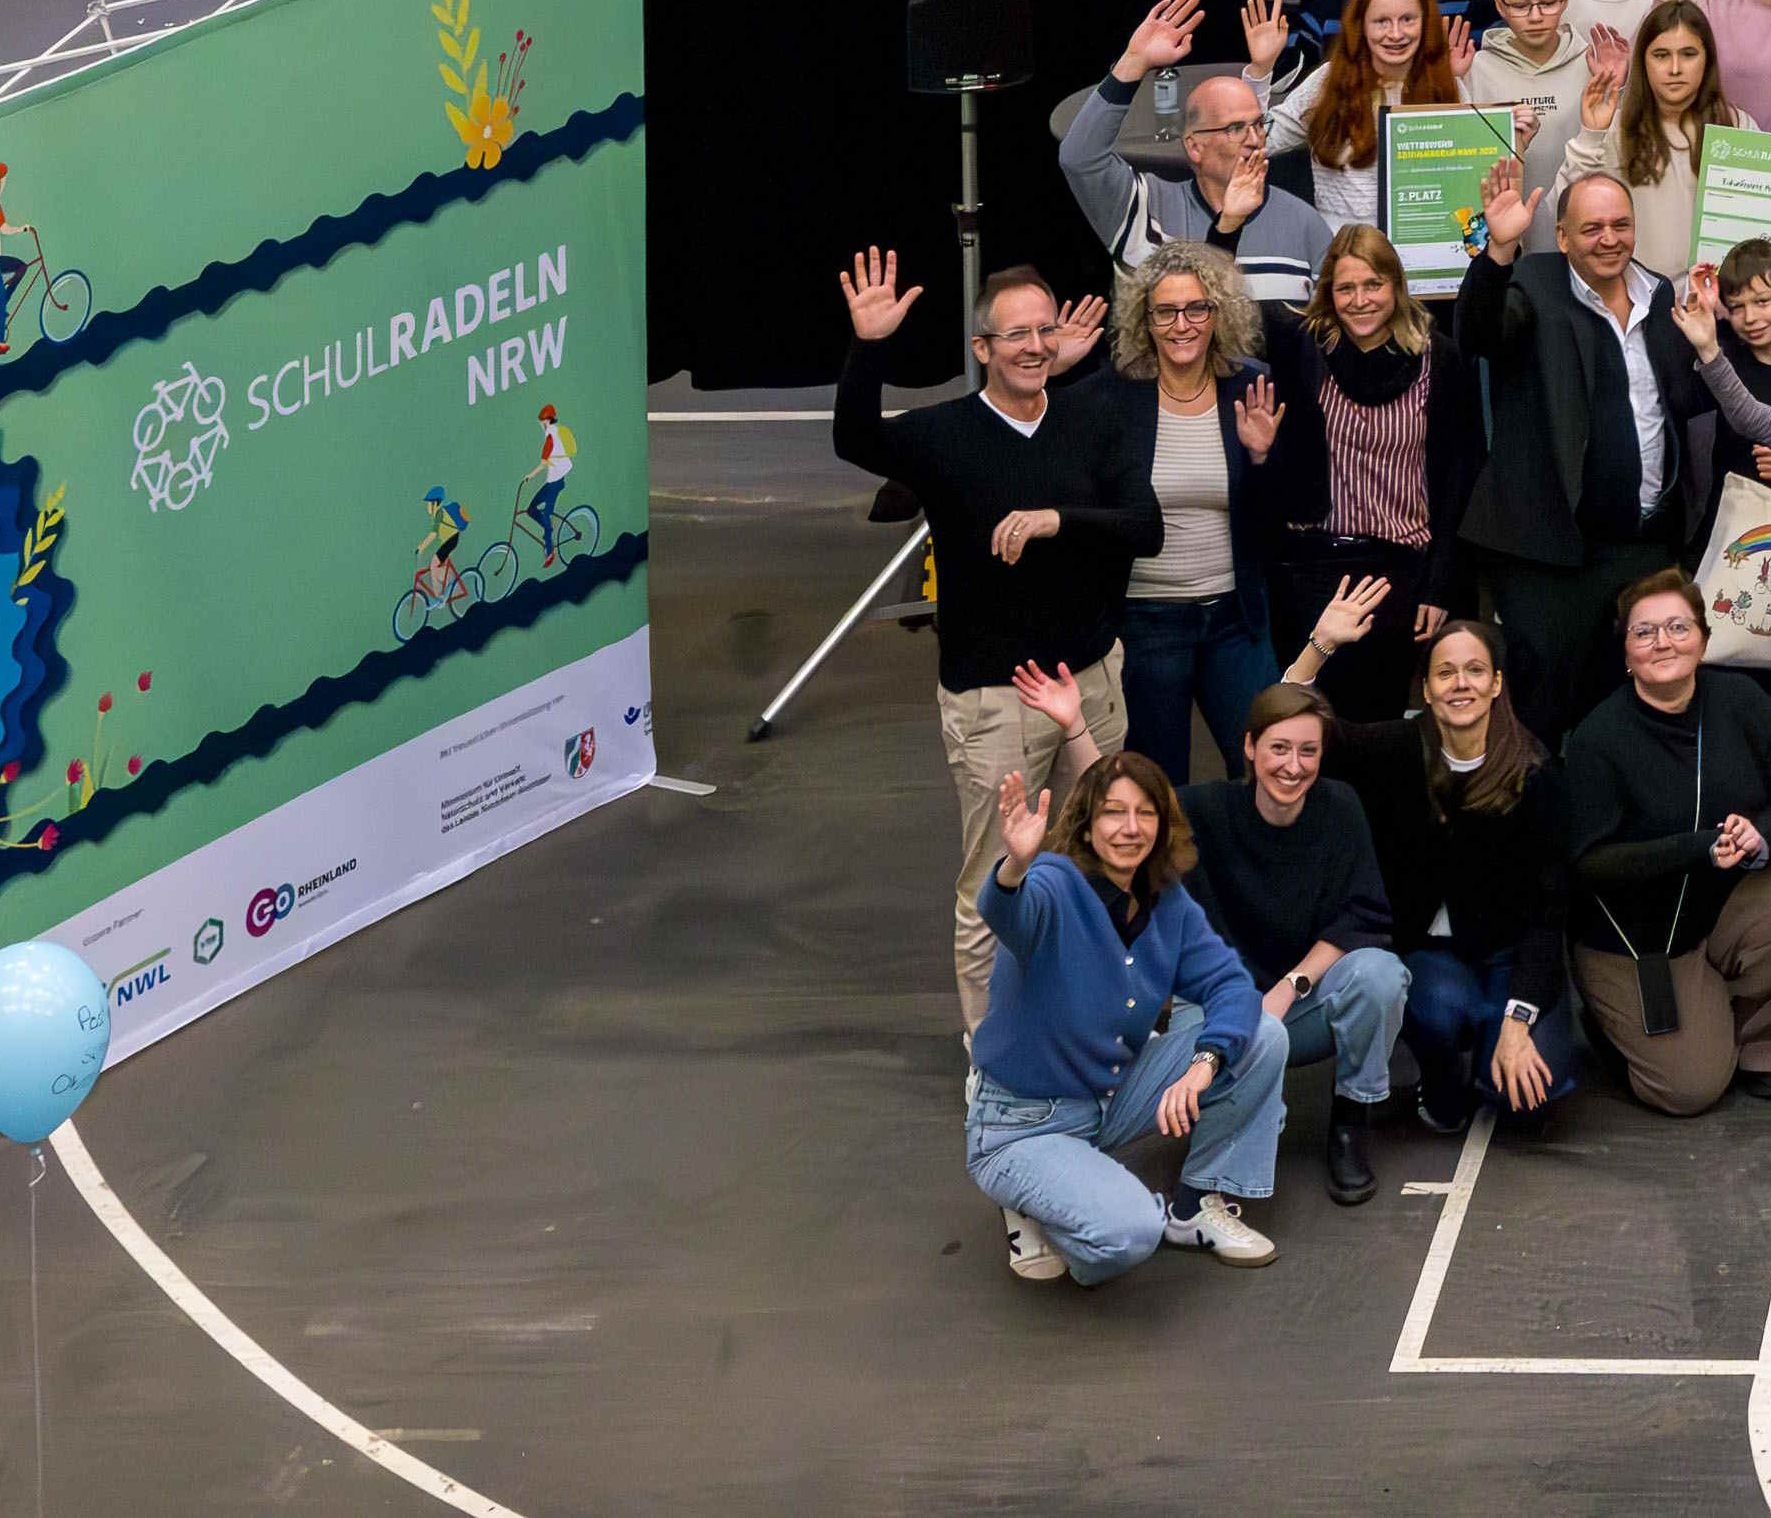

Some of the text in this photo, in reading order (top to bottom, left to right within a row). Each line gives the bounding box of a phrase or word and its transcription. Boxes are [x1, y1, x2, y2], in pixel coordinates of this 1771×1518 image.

[1521, 96, 1555, 104] FUTURE
[1398, 190, 1442, 202] 3. PLATZ
[246, 244, 568, 430] SCHULRADELN
[466, 315, 567, 406] NRW
[297, 857, 358, 898] RHEINLAND
[116, 963, 171, 1007] NWL
